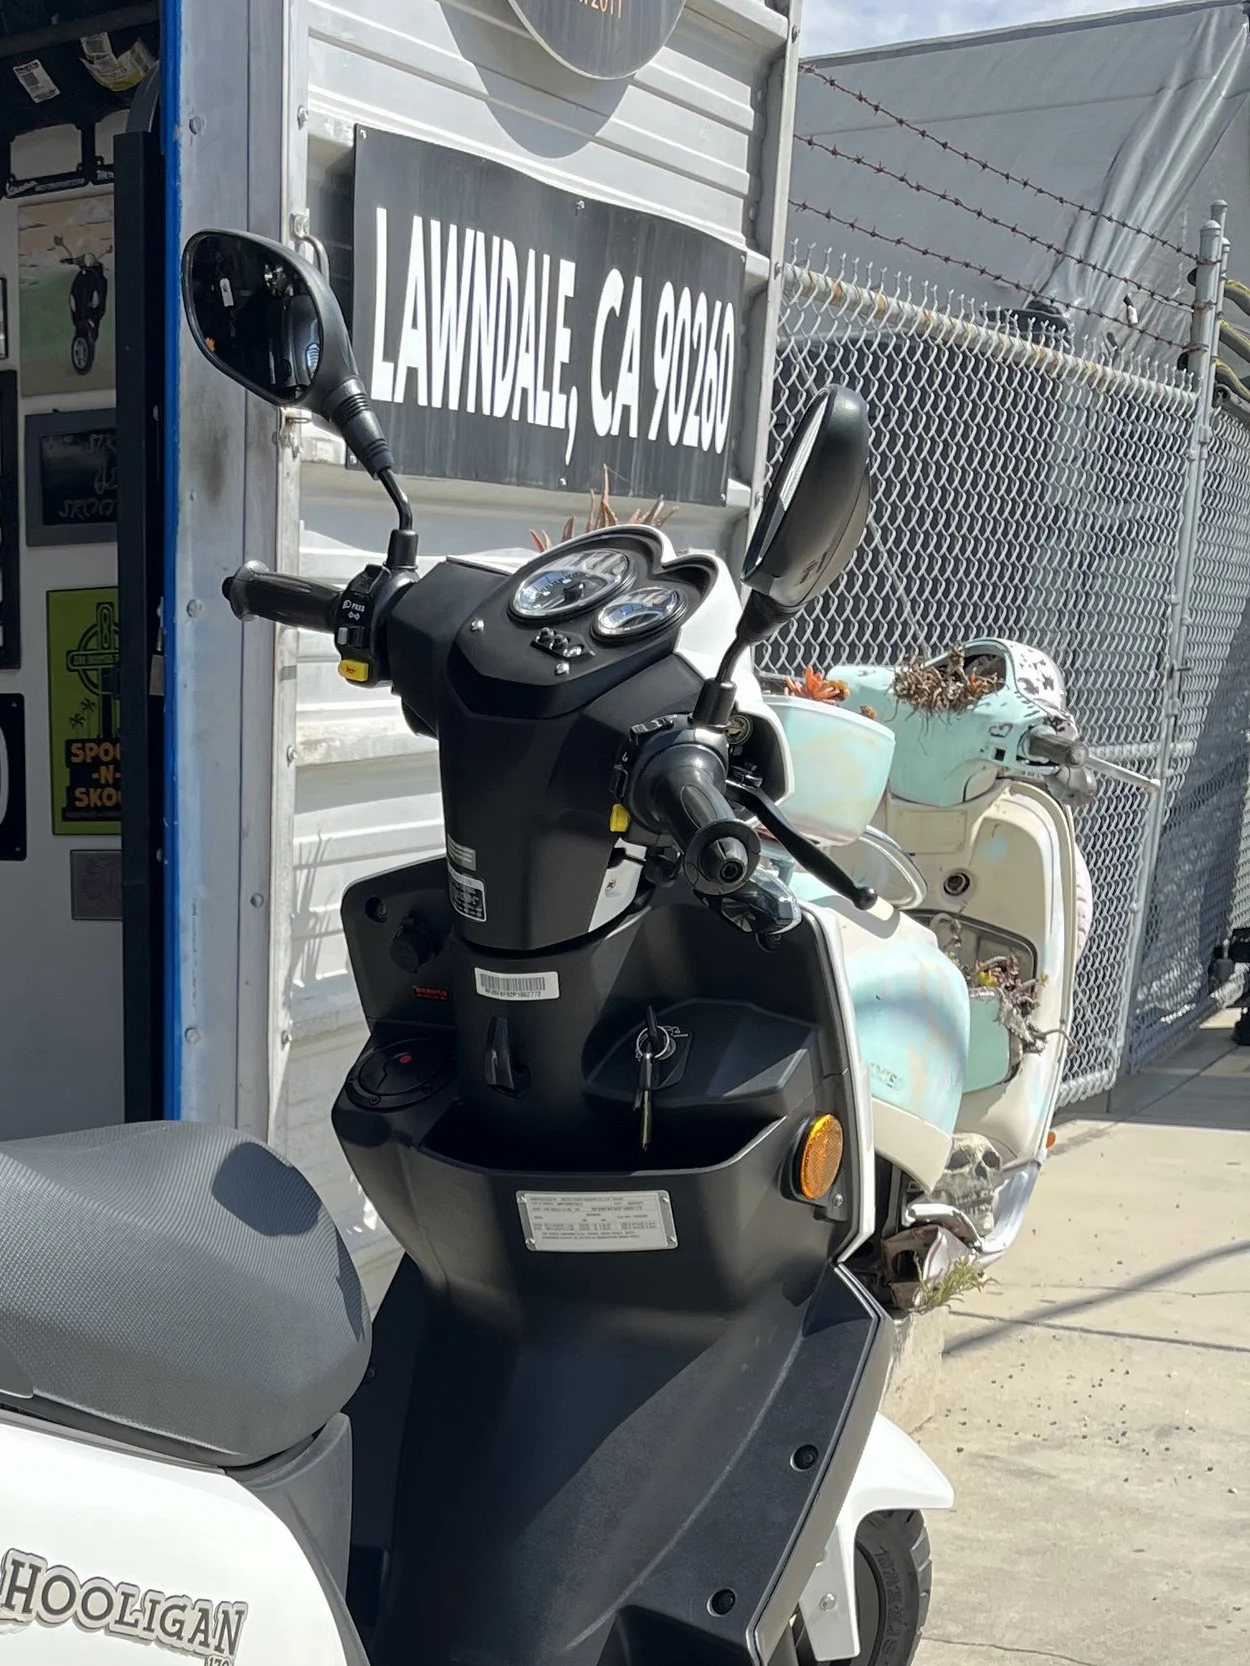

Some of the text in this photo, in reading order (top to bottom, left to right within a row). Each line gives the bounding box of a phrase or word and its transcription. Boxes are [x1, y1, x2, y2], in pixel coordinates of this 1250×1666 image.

[370, 207, 735, 466] LAWNDALE, CA 90260
[73, 787, 122, 808] SKO
[0, 1555, 246, 1658] HOOLIGAN
